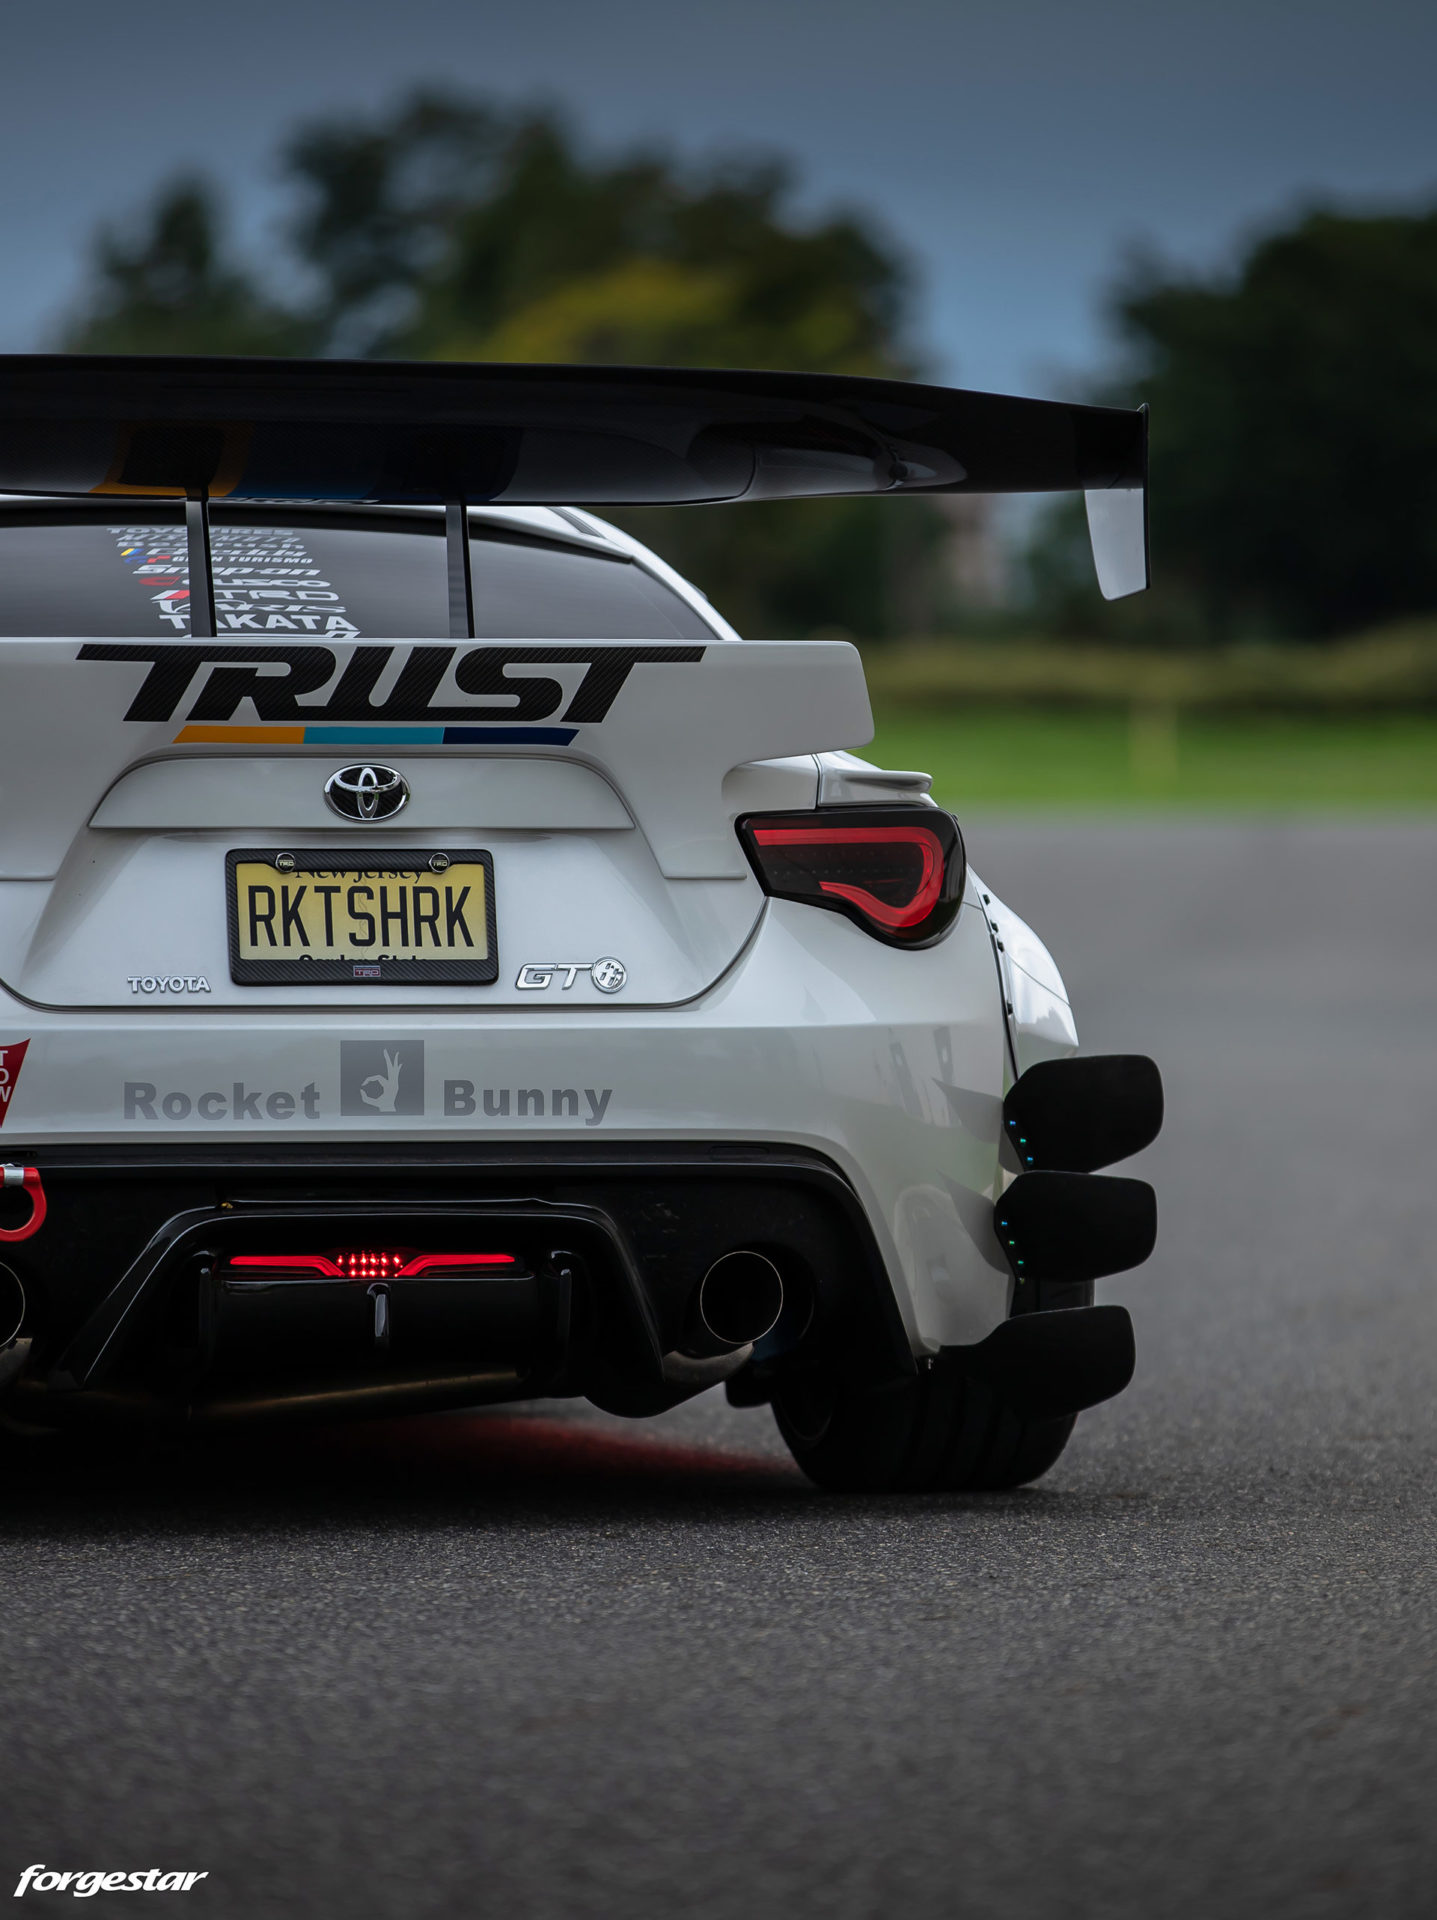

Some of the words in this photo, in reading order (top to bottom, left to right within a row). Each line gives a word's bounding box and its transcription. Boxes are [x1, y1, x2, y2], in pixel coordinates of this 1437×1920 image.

[229, 556, 313, 564] TURISMO
[211, 589, 340, 601] TRD
[75, 643, 708, 724] TRUST
[248, 885, 475, 948] RKTSHRK
[127, 976, 212, 994] TOYOTA
[123, 1081, 320, 1120] Rocket
[444, 1079, 613, 1126] Bunny
